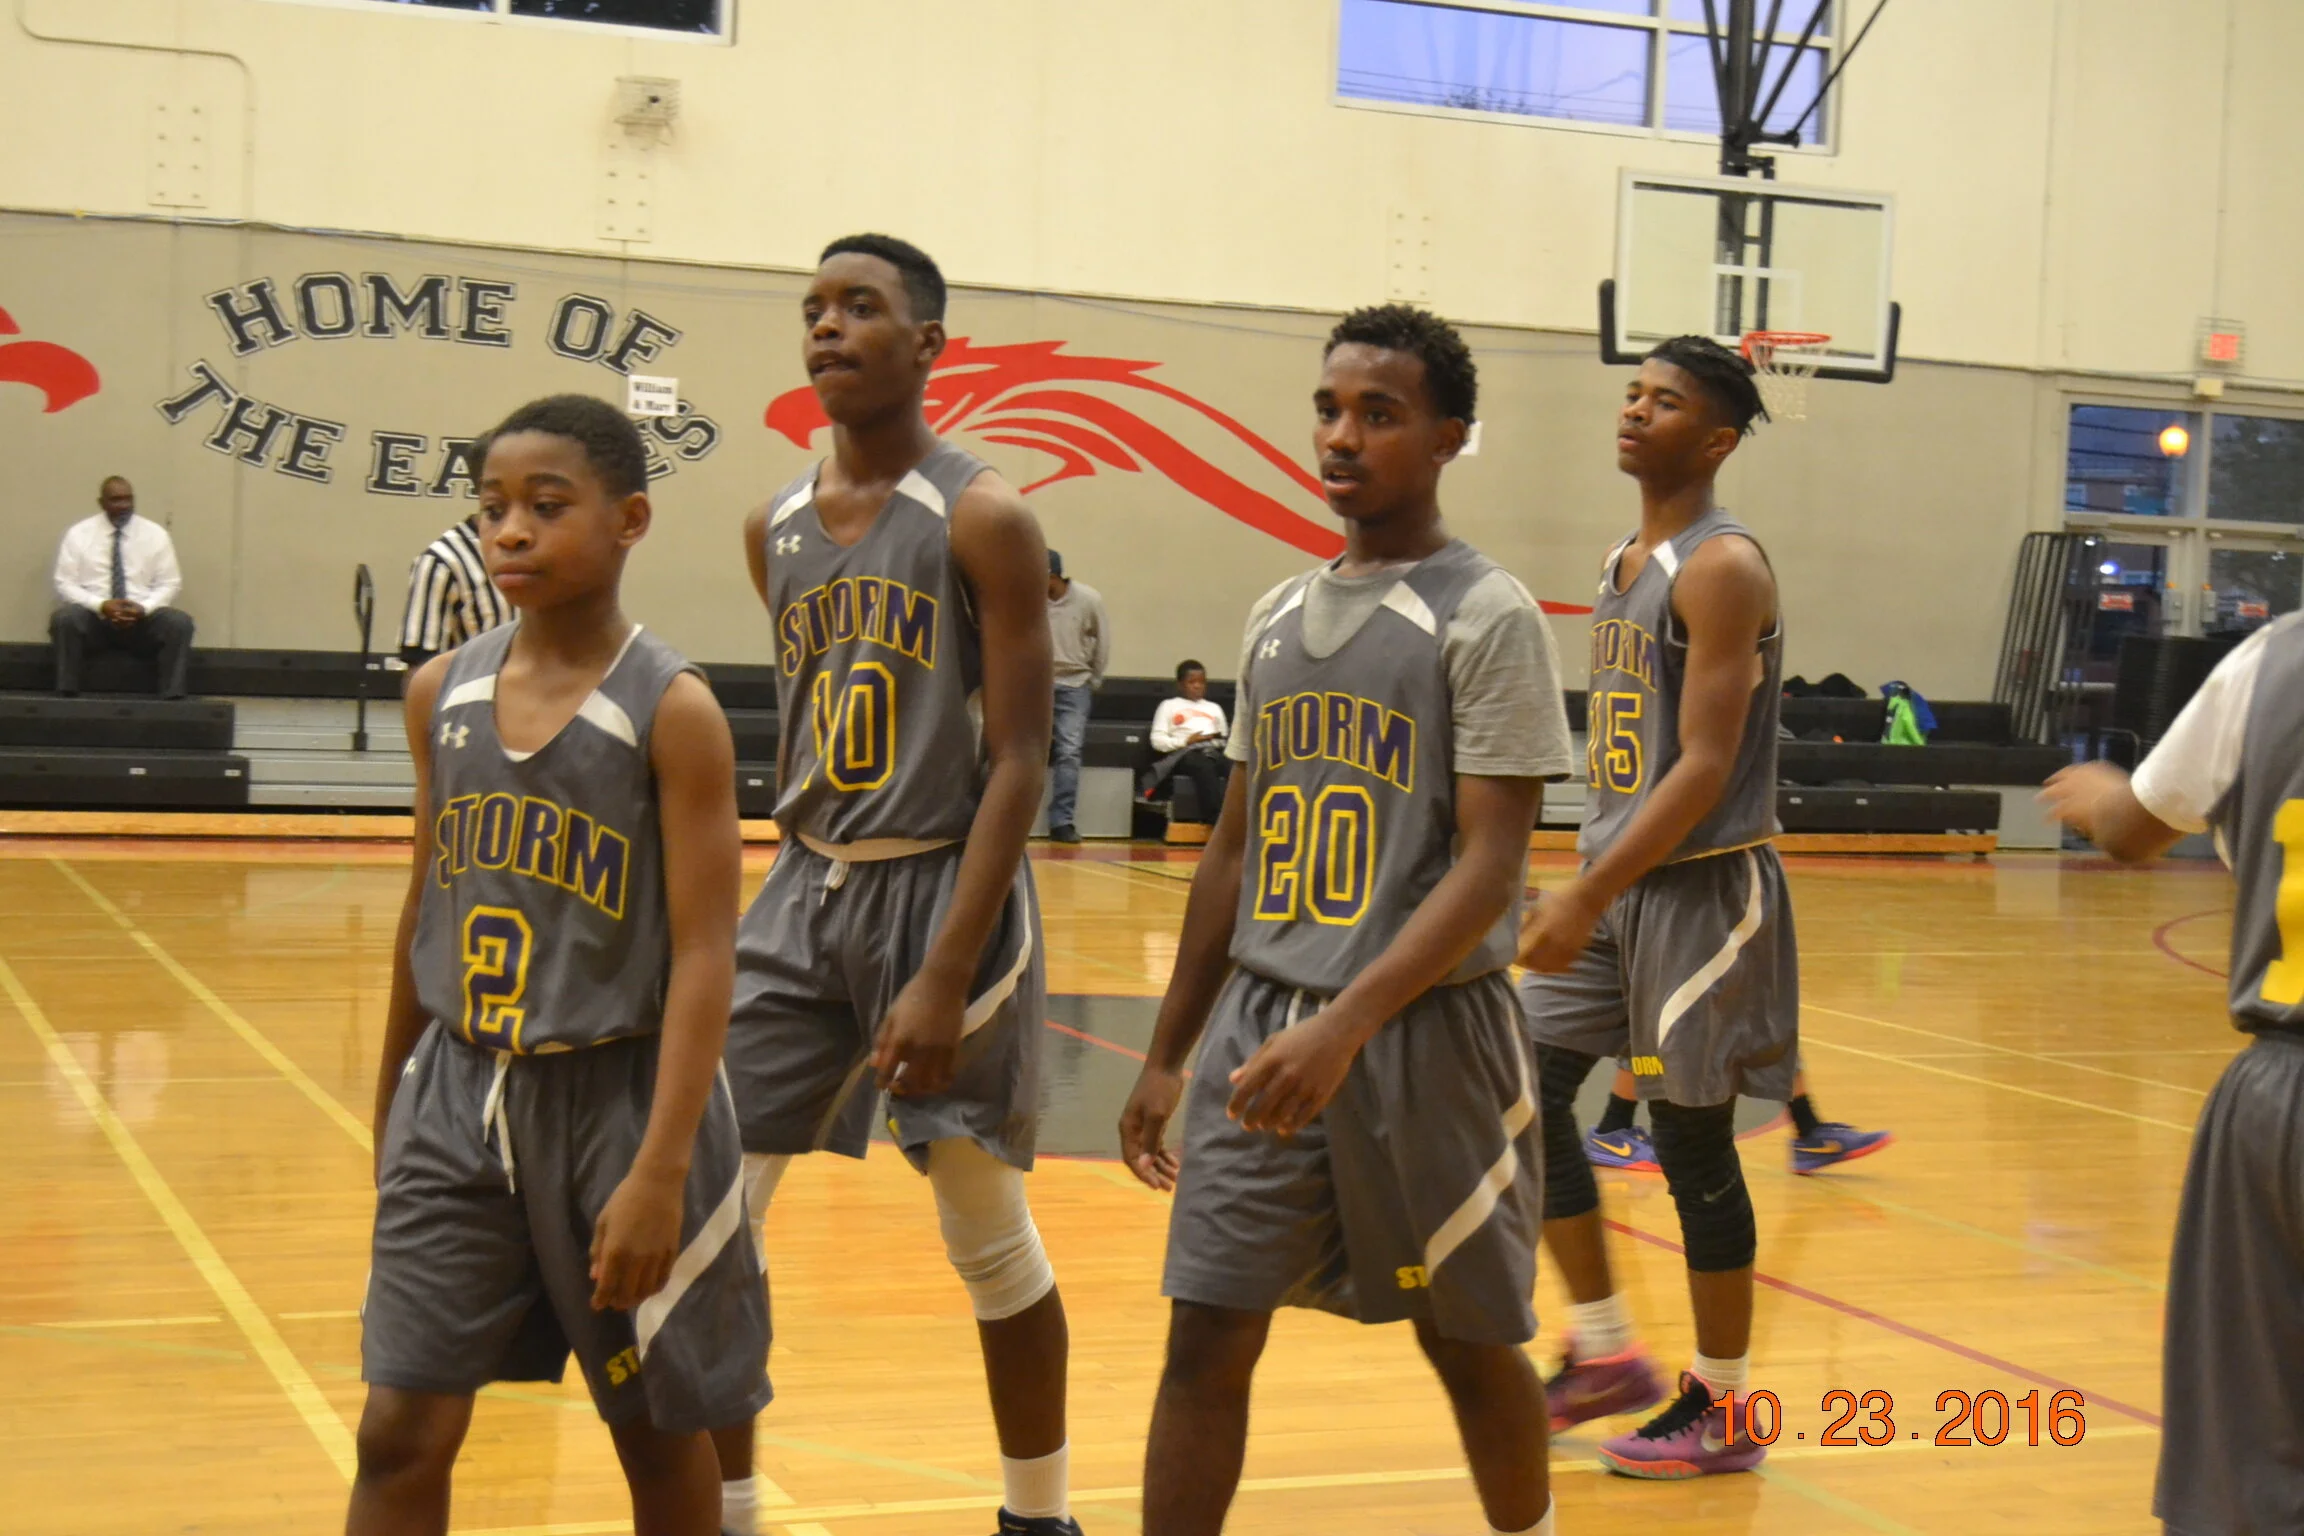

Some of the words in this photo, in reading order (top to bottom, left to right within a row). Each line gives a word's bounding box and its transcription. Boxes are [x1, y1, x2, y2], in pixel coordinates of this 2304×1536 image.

[204, 271, 516, 357] HOME
[546, 292, 683, 376] OF
[154, 358, 347, 484] THE
[779, 576, 939, 677] STORM
[801, 661, 896, 792] 10
[1252, 691, 1417, 793] TORM
[435, 791, 631, 921] STORM
[1253, 784, 1377, 927] 20
[462, 904, 534, 1056] 2
